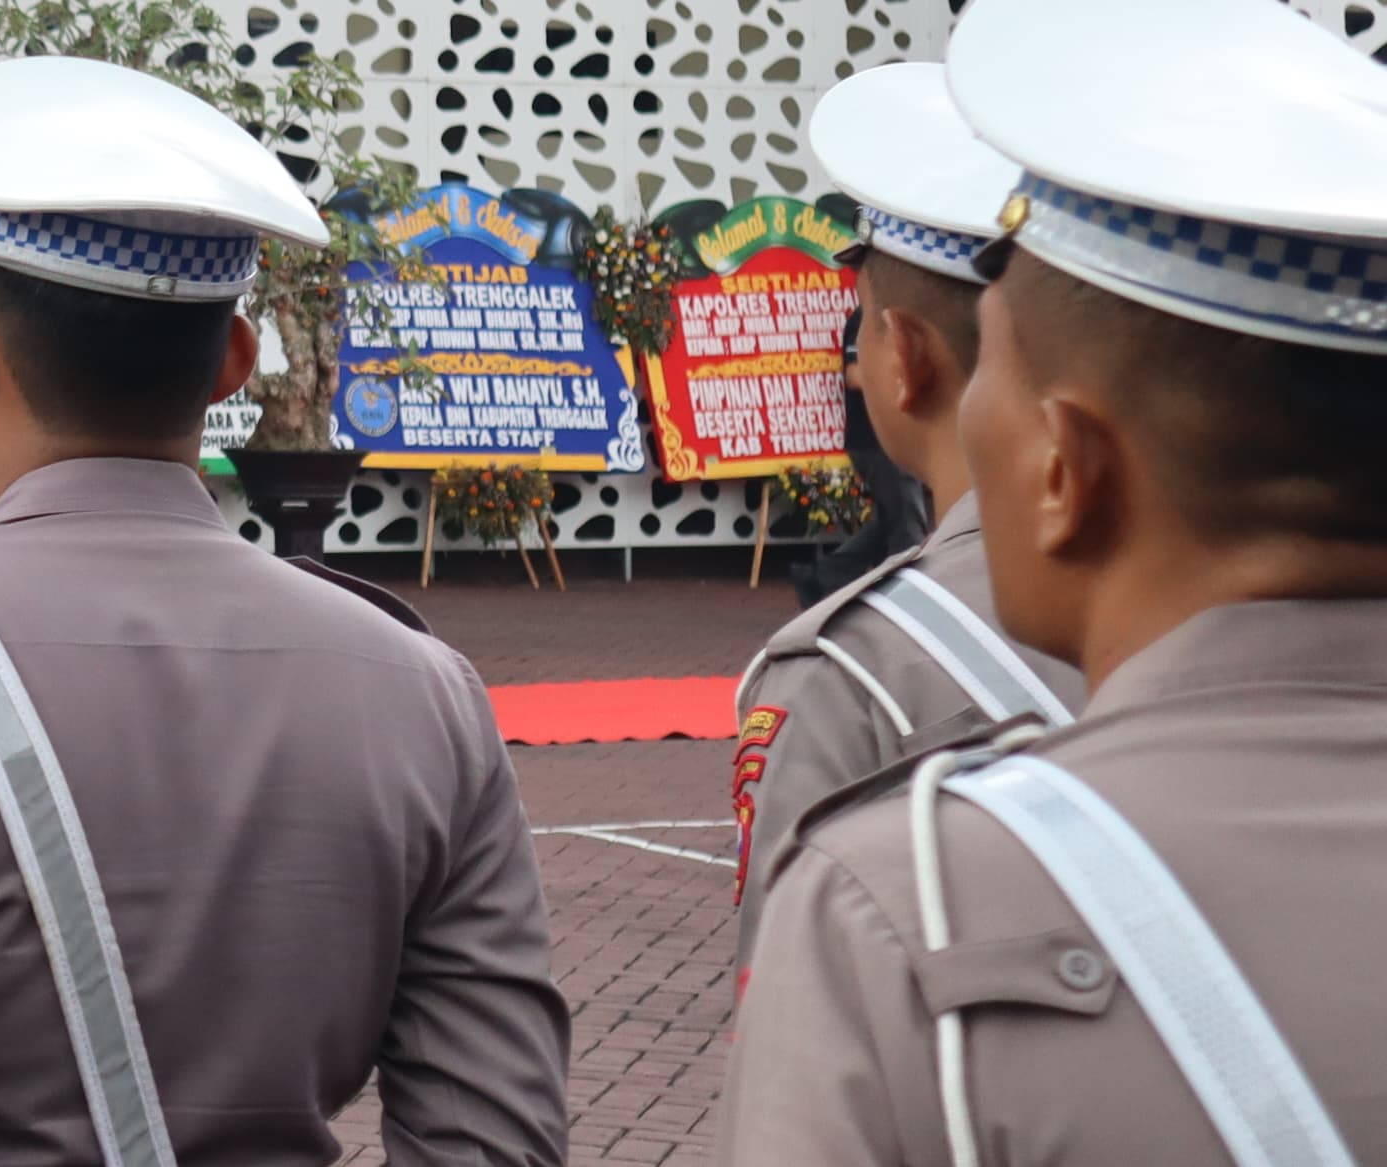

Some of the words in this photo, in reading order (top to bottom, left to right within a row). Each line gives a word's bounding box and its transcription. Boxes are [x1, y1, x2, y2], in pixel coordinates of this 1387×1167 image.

[721, 272, 841, 294] SERTIJAB
[452, 285, 576, 309] TRENGGALEK
[679, 293, 771, 320] KAPOLRES
[449, 377, 490, 404] WIJI
[493, 377, 568, 408] RAHAYU,
[688, 377, 763, 411] PIMPINAN
[761, 375, 796, 408] DAN
[400, 406, 443, 427] KEPALA
[474, 407, 536, 429] KABUPATEN
[538, 408, 608, 430] TRENGGALEK
[694, 408, 766, 439] BESERTA
[403, 429, 493, 447] BESERTA
[497, 430, 555, 448] STAFF
[720, 435, 763, 458] KAB
